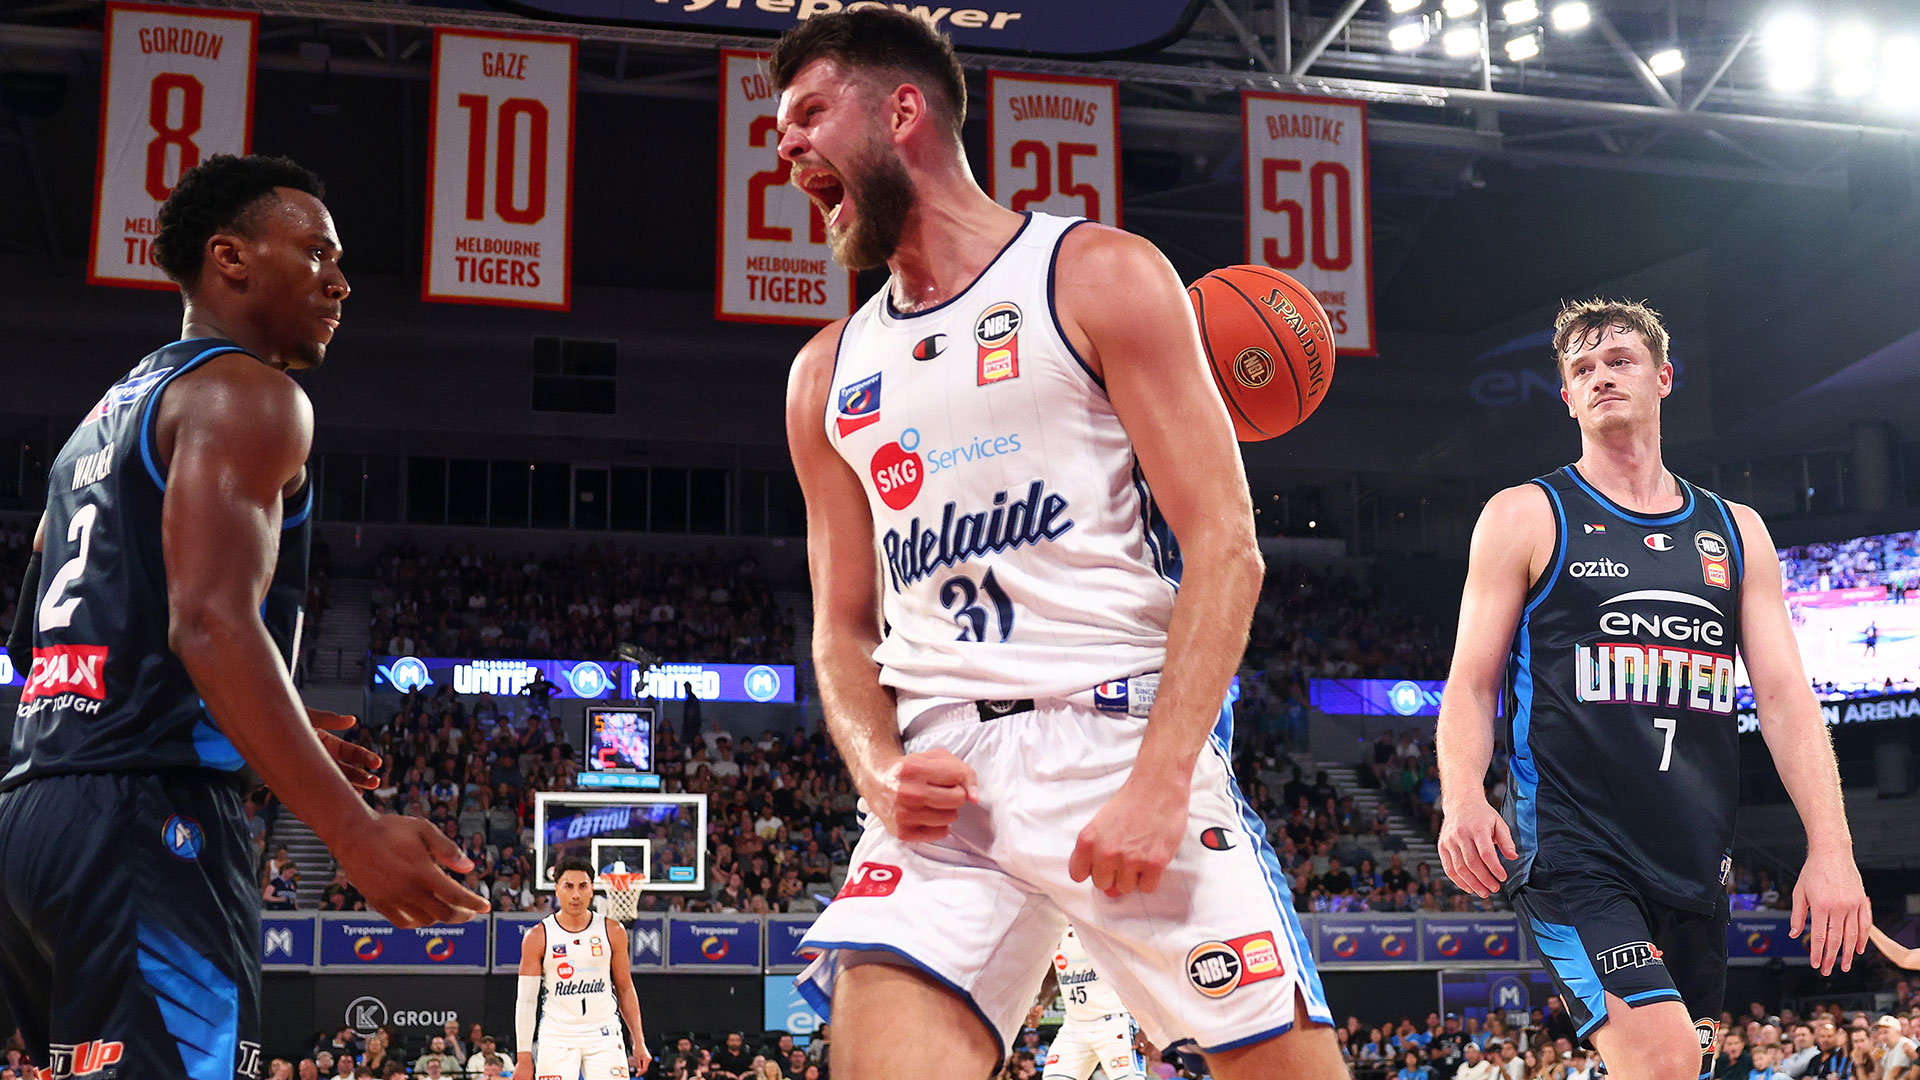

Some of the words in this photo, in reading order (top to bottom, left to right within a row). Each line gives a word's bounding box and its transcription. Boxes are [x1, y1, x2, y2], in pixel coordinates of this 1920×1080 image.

[655, 0, 1022, 30] epwer
[138, 27, 224, 60] GORDON
[482, 51, 528, 80] GAZE
[1008, 94, 1098, 127] SIMMONS
[145, 72, 204, 202] 8
[1265, 114, 1345, 145] BRADTKE
[457, 93, 549, 226] 10
[1010, 138, 1100, 221] 25
[1262, 157, 1352, 271] 50
[455, 236, 541, 258] MELBOURNE
[455, 256, 541, 288] TIGERS
[747, 256, 827, 276] MELBOURNE
[747, 275, 827, 305] TIGERS
[982, 313, 1012, 339] NBL
[1260, 288, 1325, 400] SPALDING
[1242, 354, 1265, 381] NBL
[927, 432, 1022, 474] Services
[875, 458, 918, 495] SKG
[882, 478, 1075, 595] Adelaide
[1701, 538, 1723, 554] NBL
[38, 503, 97, 632] 2
[1569, 557, 1630, 578] ozito
[940, 566, 1017, 643] 31
[1134, 687, 1156, 695] SINC
[1576, 643, 1736, 716] UNITED
[52, 694, 101, 716] TOUGH
[1843, 698, 1920, 723] ARENA
[1653, 717, 1677, 772] 7
[342, 924, 394, 936] Tyrepower
[415, 926, 465, 938] Tyrepower
[689, 925, 739, 937] Tyrepower
[1194, 955, 1232, 985] NBL
[555, 978, 605, 996] Adelaide
[1069, 985, 1087, 1005] 45
[393, 1010, 458, 1027] GROUP
